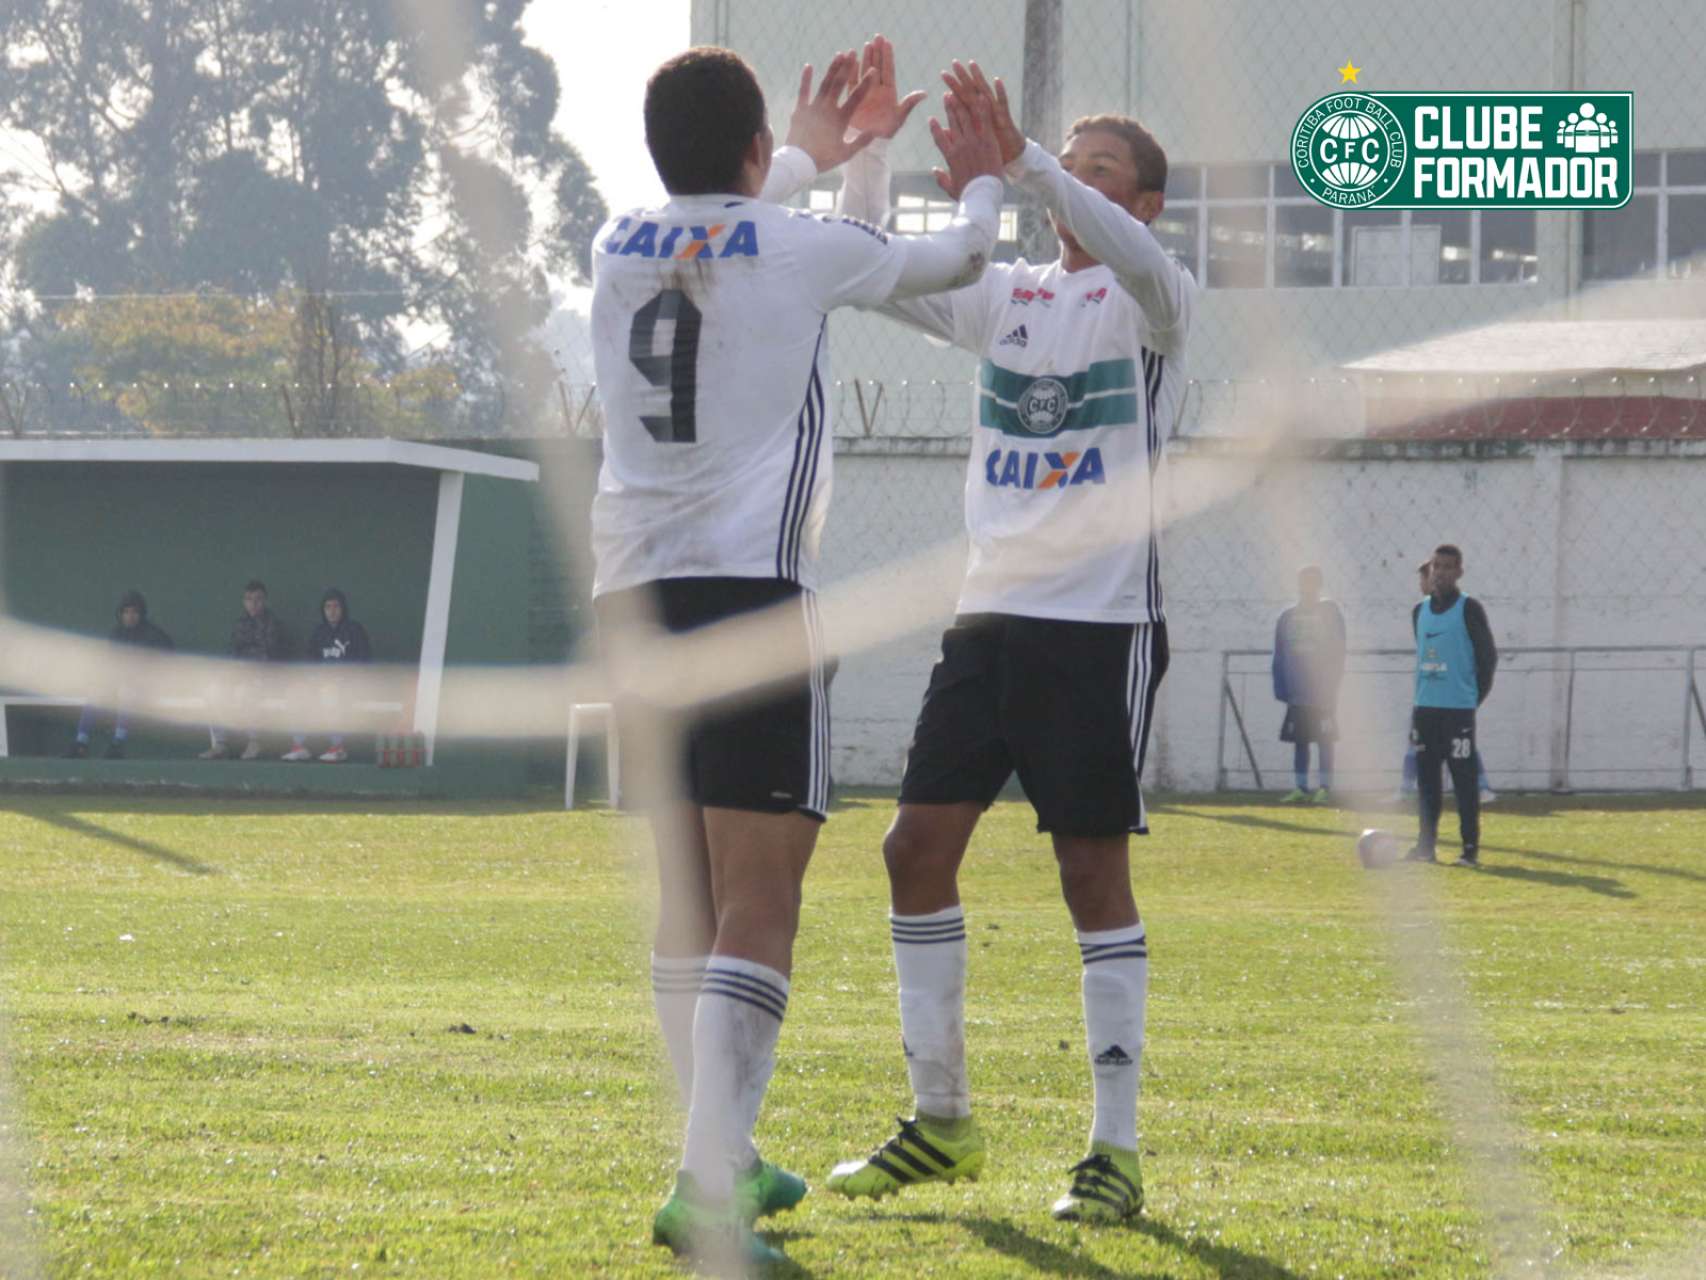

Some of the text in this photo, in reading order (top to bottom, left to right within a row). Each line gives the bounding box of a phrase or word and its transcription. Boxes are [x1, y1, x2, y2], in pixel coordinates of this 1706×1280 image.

[628, 289, 703, 443] 9
[985, 447, 1107, 490] CAIXA
[1452, 738, 1471, 758] 28
